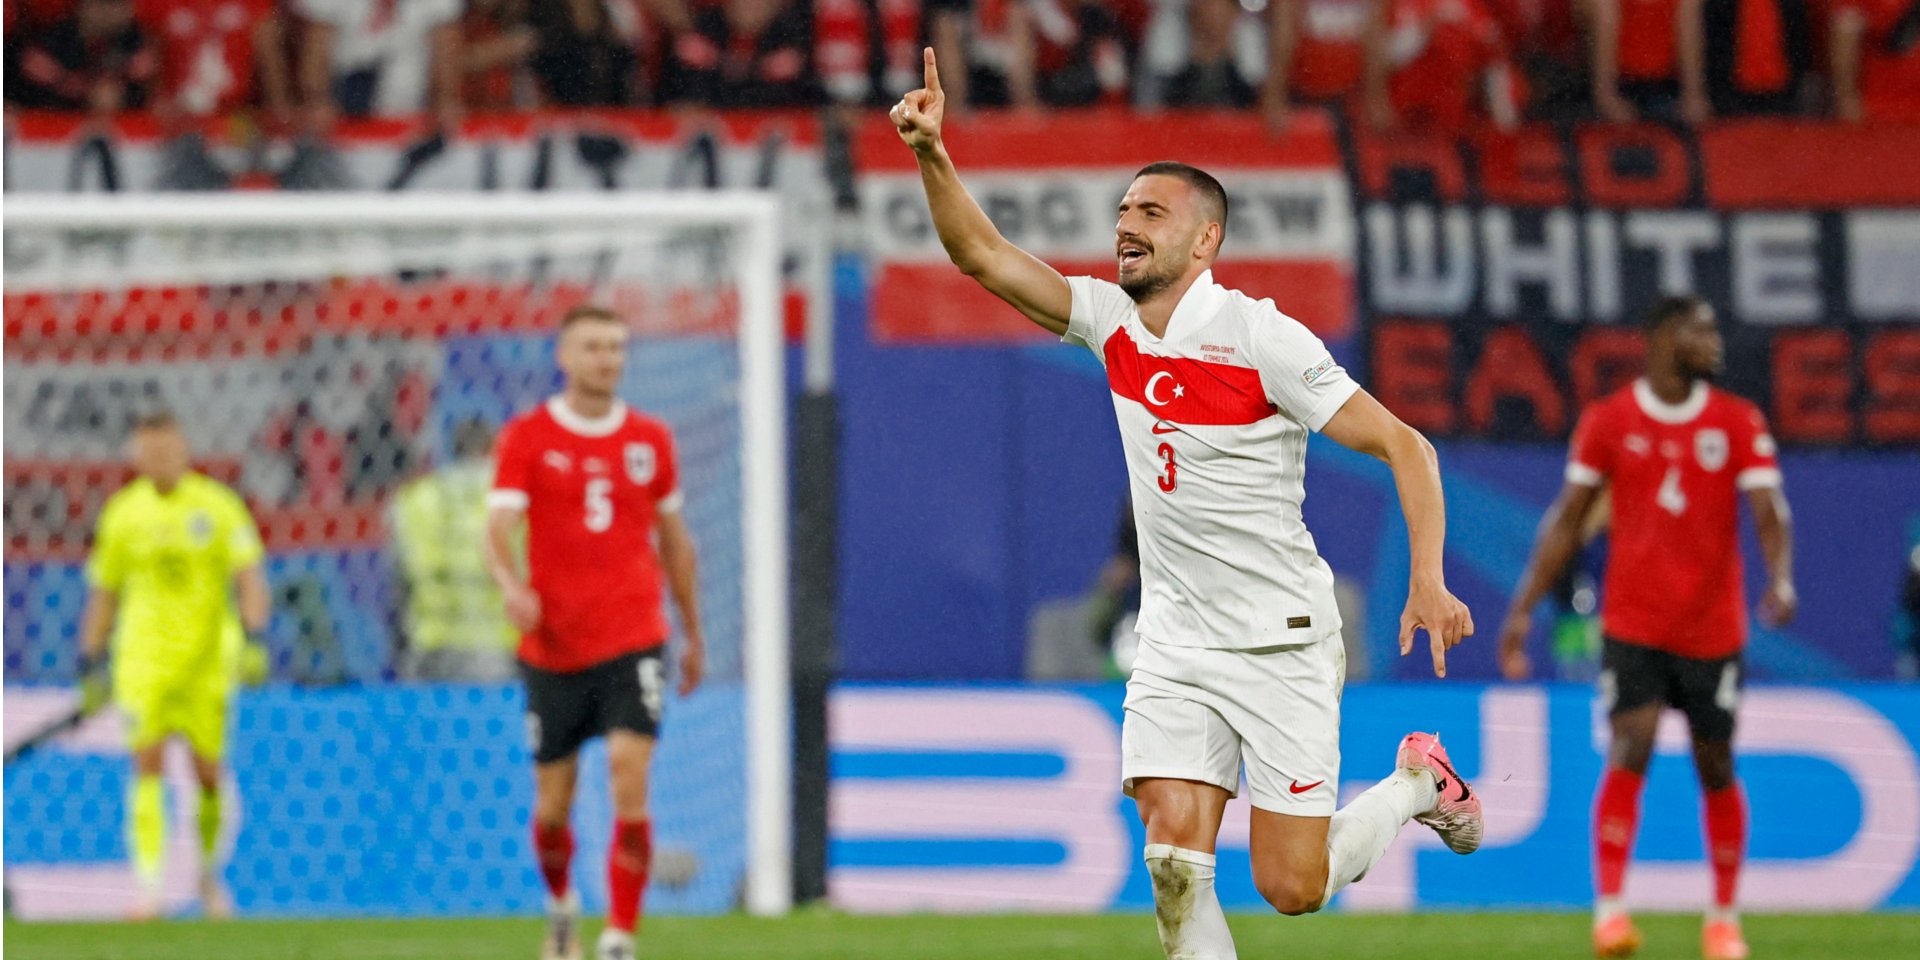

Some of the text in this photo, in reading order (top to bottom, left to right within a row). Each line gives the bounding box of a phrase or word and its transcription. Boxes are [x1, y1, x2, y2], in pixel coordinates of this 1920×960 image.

[1363, 203, 1823, 323] WHITE
[1157, 442, 1177, 494] 3
[1656, 464, 1688, 517] 4
[584, 478, 614, 533] 5
